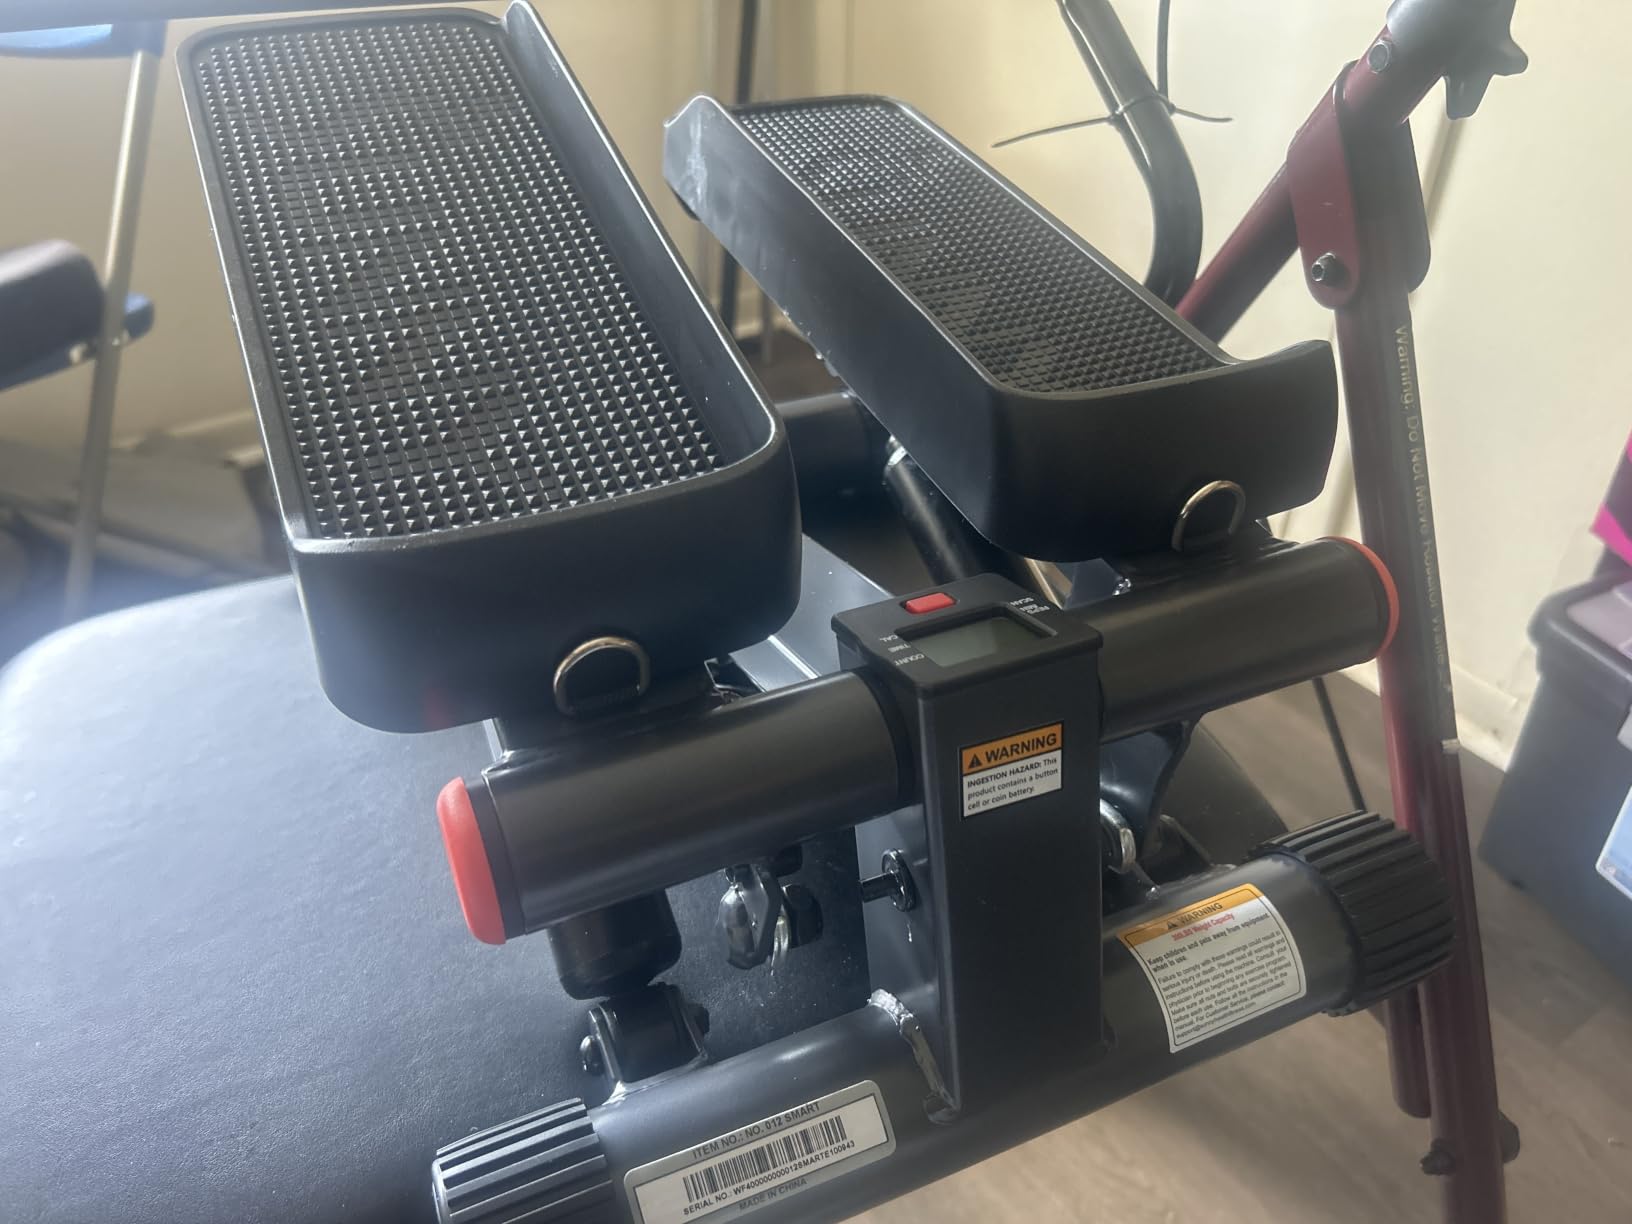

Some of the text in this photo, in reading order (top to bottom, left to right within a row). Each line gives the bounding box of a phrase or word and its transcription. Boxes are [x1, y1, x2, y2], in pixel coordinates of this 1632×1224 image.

[1395, 326, 1415, 410] Warning:
[1406, 415, 1419, 442] Do
[1410, 447, 1424, 481] Not
[894, 653, 925, 666] COUNT
[984, 733, 1057, 763] WARNING
[967, 757, 1058, 788] INGESTION HAZARD: This
[967, 785, 996, 801] product
[997, 776, 1027, 791] contains
[1034, 768, 1059, 781] button
[967, 798, 981, 810] cell
[982, 798, 991, 807] or
[991, 792, 1008, 804] coin
[1177, 902, 1223, 924] WARNING
[691, 1102, 820, 1159] ITEM NO.: NO. 012 SMART
[683, 1199, 714, 1216] SERIAL
[739, 1178, 807, 1210] MADE IN CHINA
